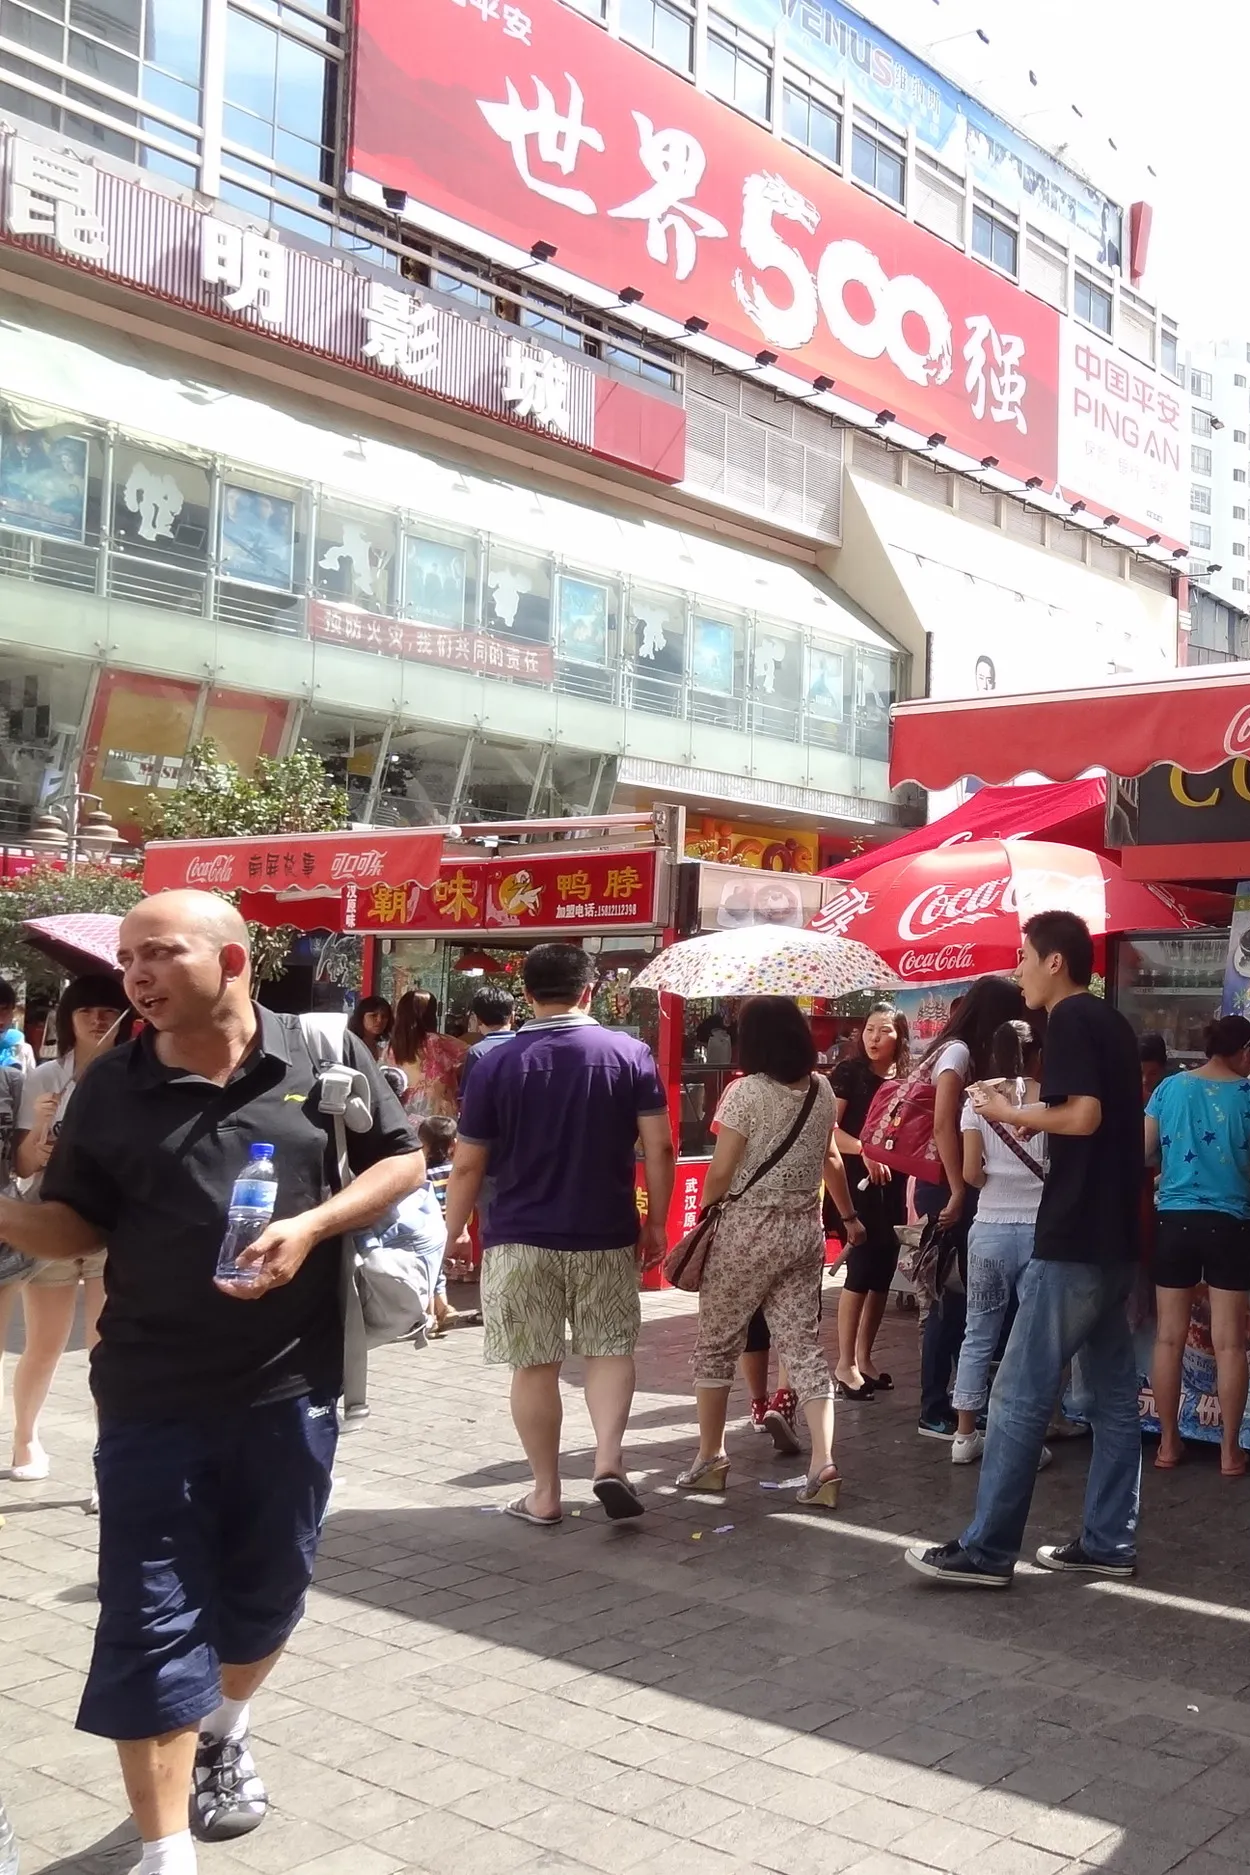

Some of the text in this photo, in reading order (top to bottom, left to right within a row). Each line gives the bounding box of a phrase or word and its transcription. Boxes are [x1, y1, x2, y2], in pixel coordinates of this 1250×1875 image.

[476, 70, 1029, 436] 世界500强
[4, 134, 573, 437] 昆明影城
[1074, 344, 1181, 432] 中国平安
[1074, 387, 1140, 449] PING
[331, 849, 388, 879] 可口可乐
[557, 865, 644, 901] 鸭脖
[899, 943, 975, 977] Coca-Cola
